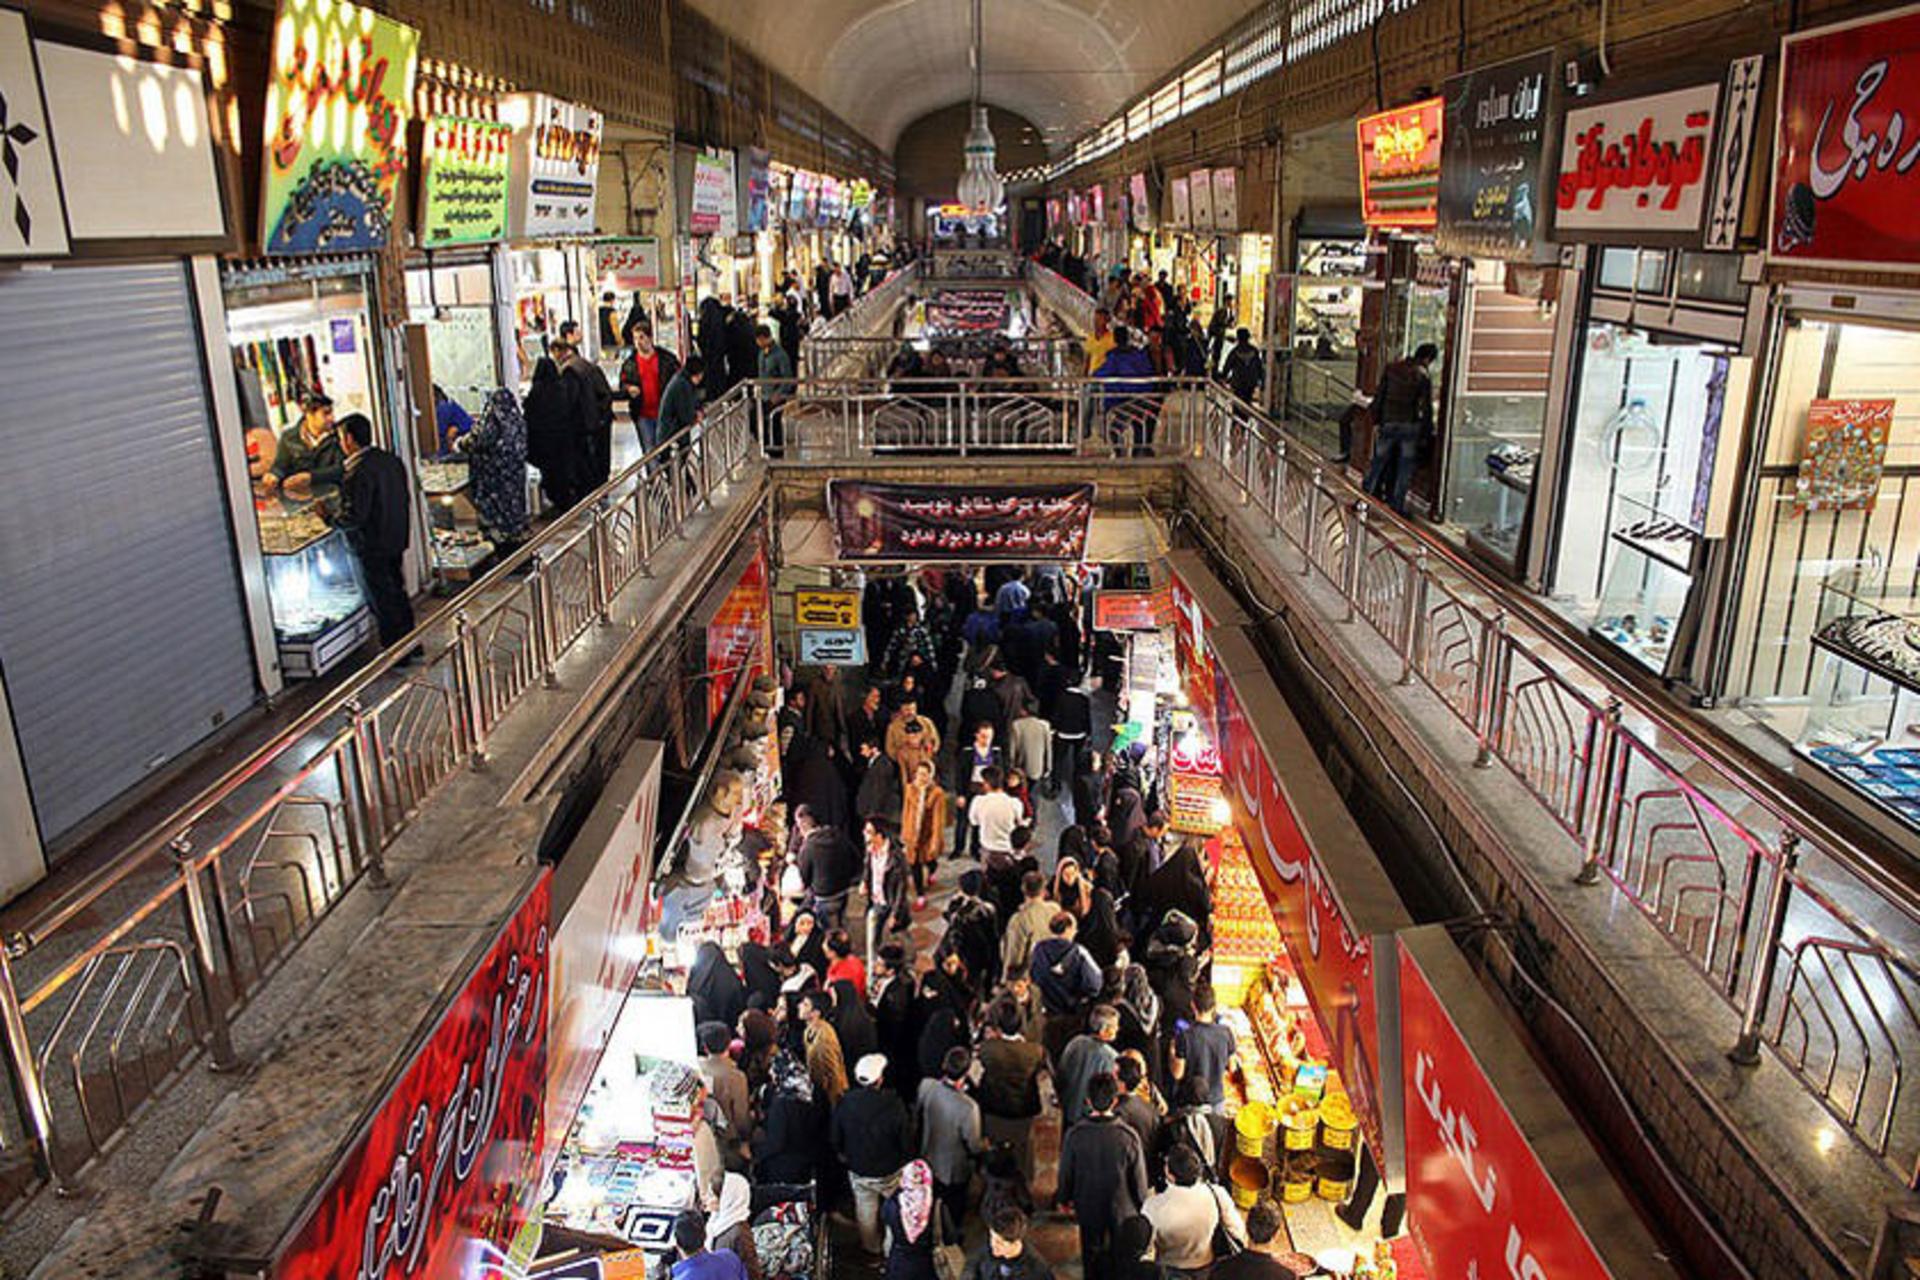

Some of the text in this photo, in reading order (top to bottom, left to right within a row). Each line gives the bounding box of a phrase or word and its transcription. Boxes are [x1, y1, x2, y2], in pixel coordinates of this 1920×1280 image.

[1475, 72, 1543, 129] ایران سیلور
[955, 495, 994, 521] شقایق
[900, 528, 936, 549] ندارد
[938, 529, 973, 551] دیوار
[454, 923, 549, 1182] زعفران
